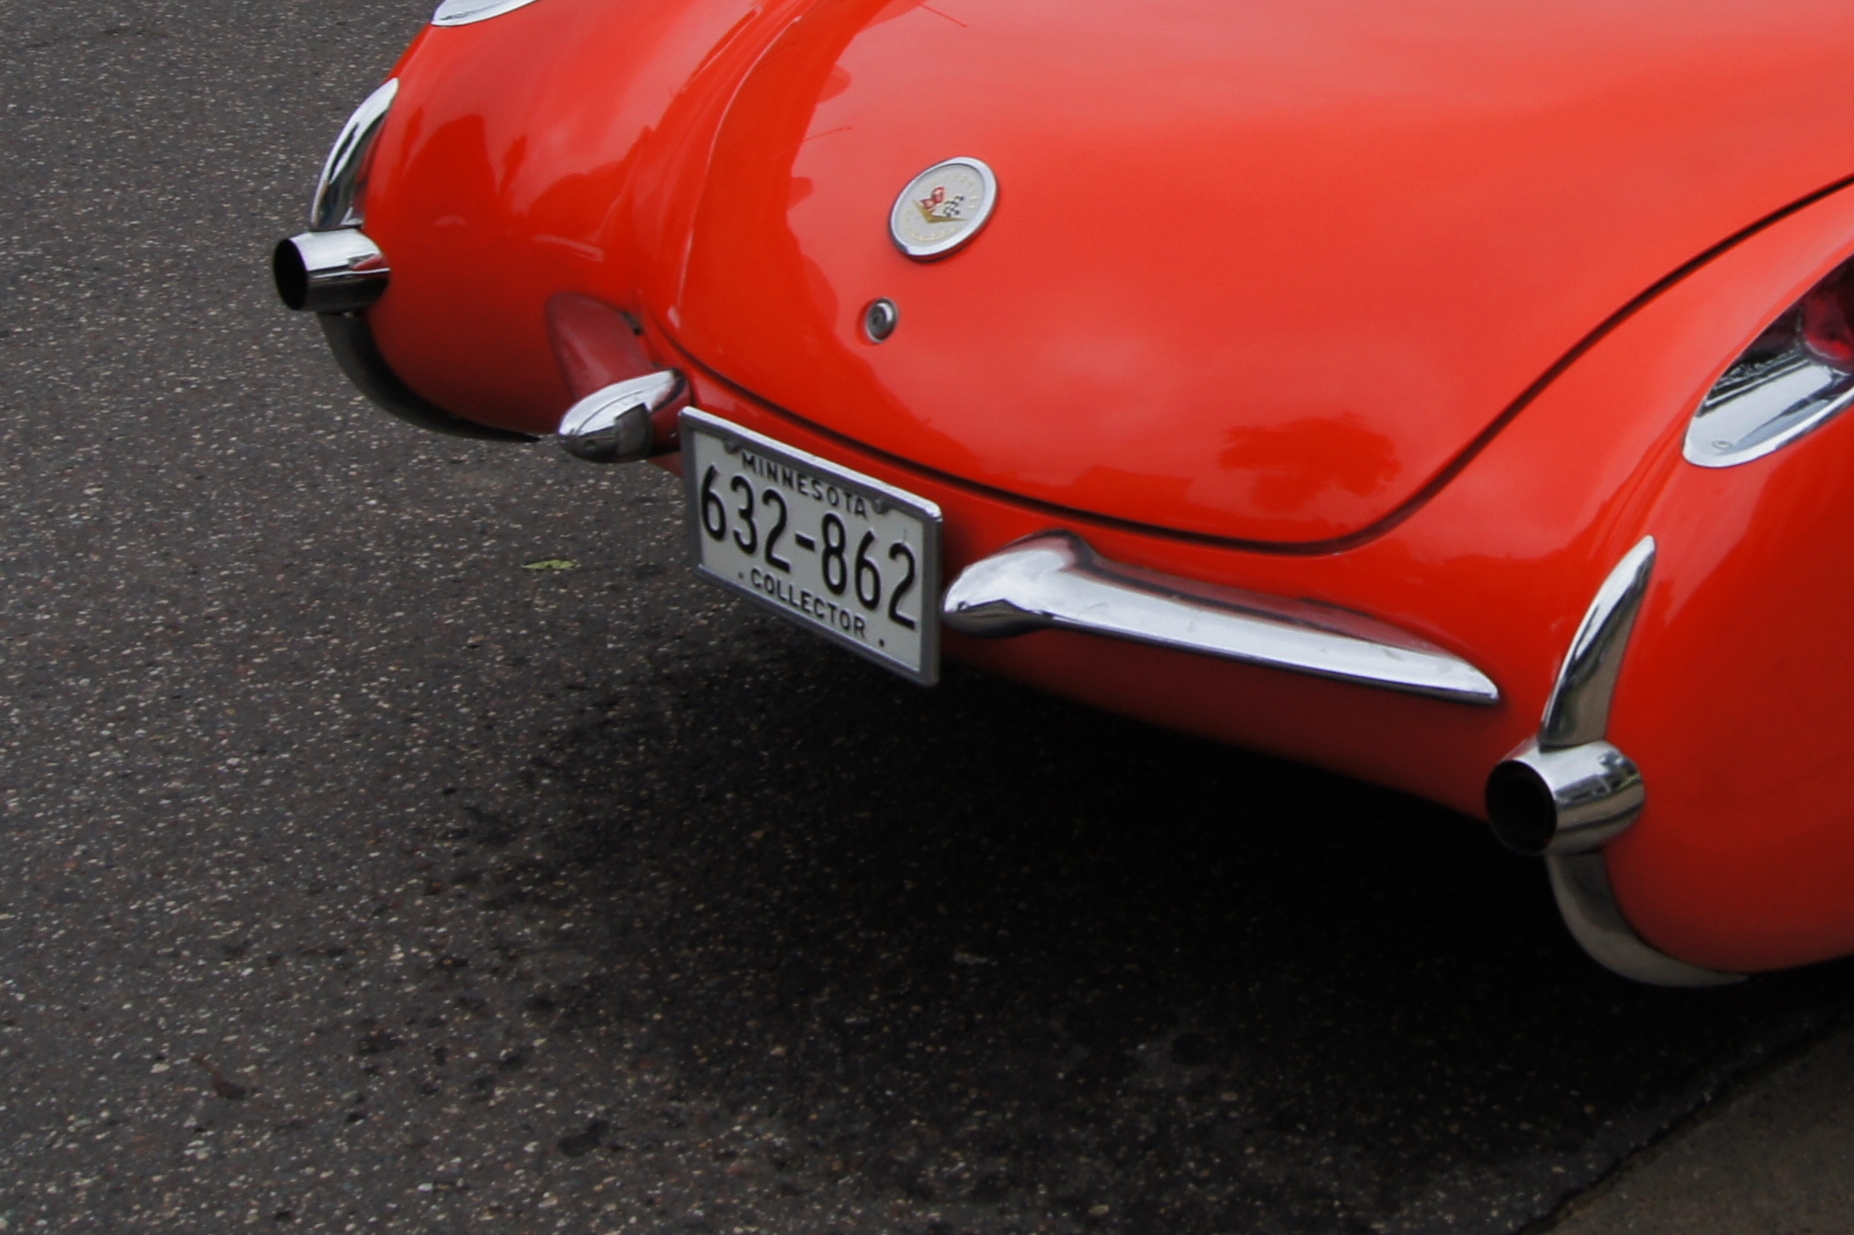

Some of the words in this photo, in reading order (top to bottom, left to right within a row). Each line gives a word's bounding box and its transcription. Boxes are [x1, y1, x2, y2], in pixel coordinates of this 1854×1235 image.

[741, 451, 867, 518] MINNESOTA
[701, 462, 917, 631] 632-862
[750, 567, 866, 637] COLLECTOR
